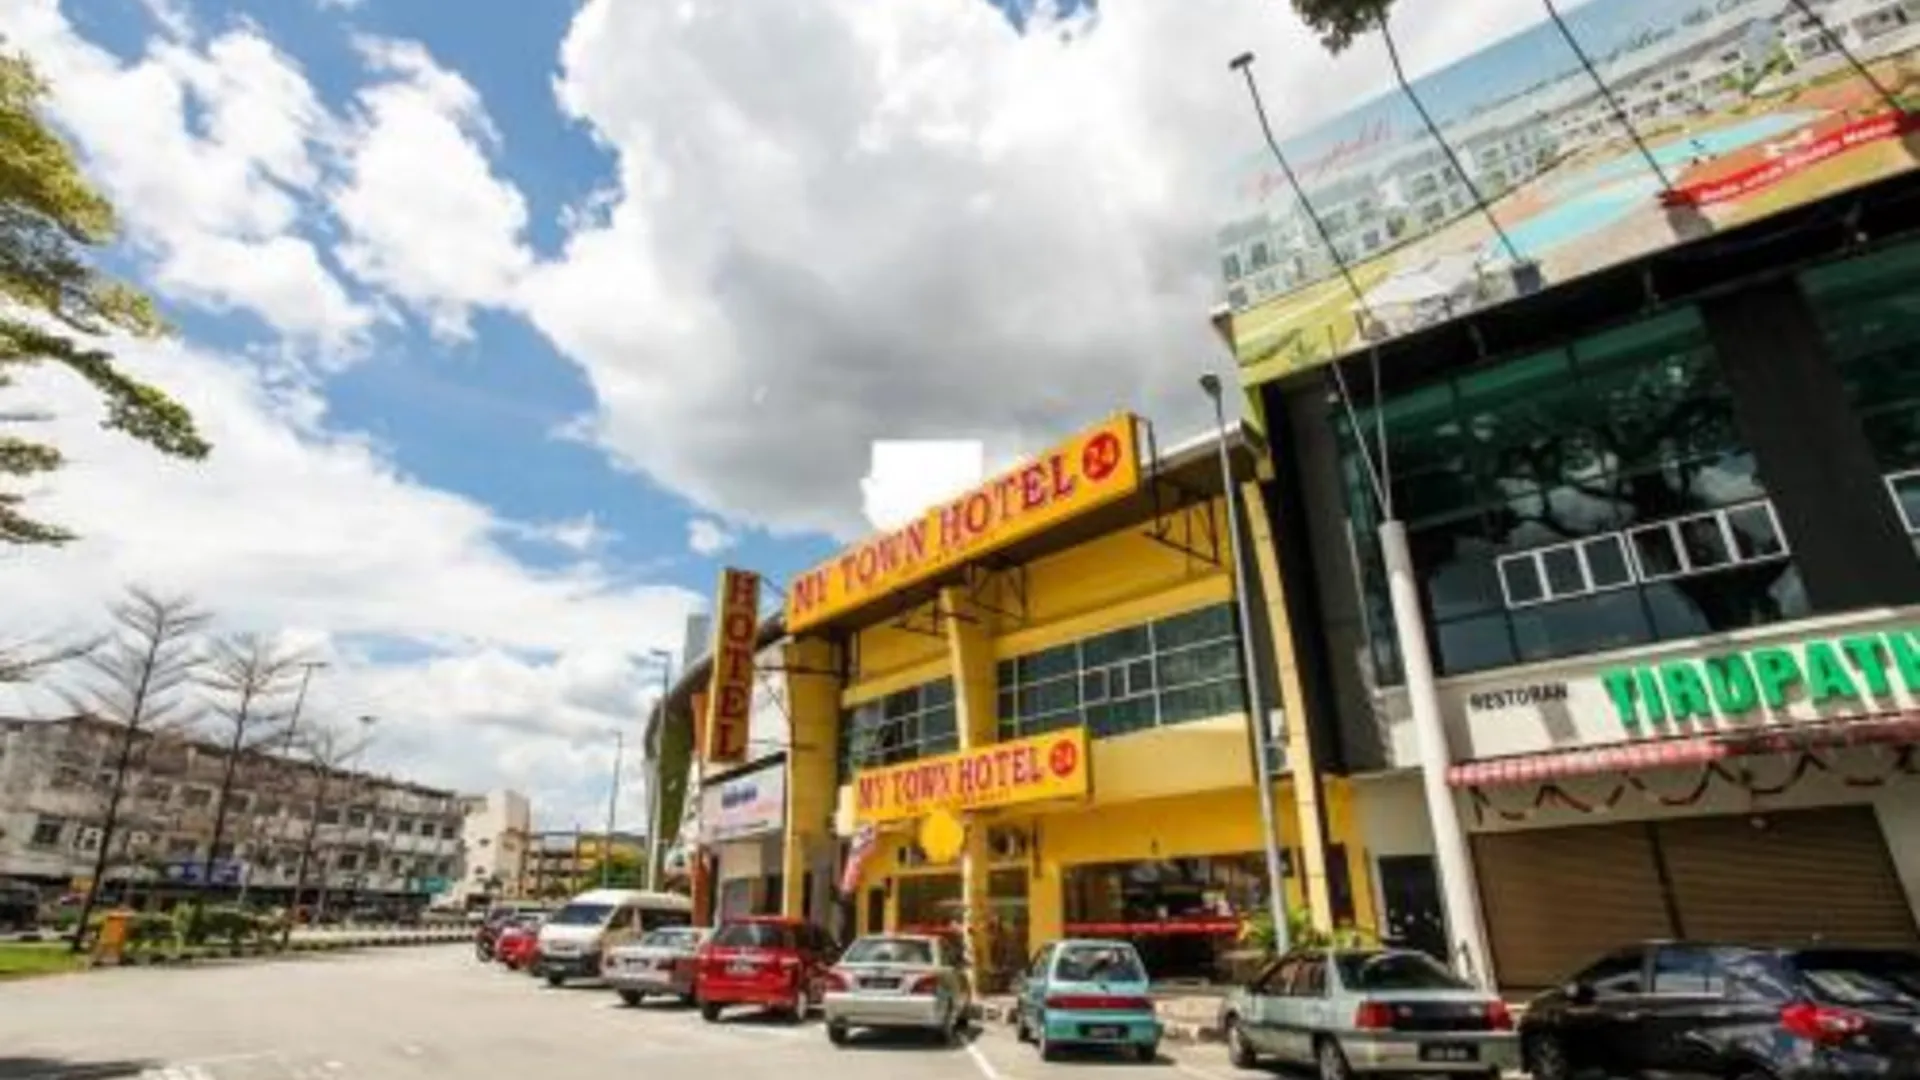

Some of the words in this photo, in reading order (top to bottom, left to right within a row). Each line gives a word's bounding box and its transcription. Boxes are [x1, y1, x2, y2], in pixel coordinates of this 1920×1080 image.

[793, 565, 829, 613] MY
[840, 517, 928, 594] TOWN
[940, 453, 1077, 548] HOTEL
[717, 572, 758, 757] HOTEL
[1470, 683, 1567, 711] RESTORAN
[859, 772, 886, 809] MY
[893, 761, 952, 804] TOWN
[957, 745, 1043, 797] HOTEL
